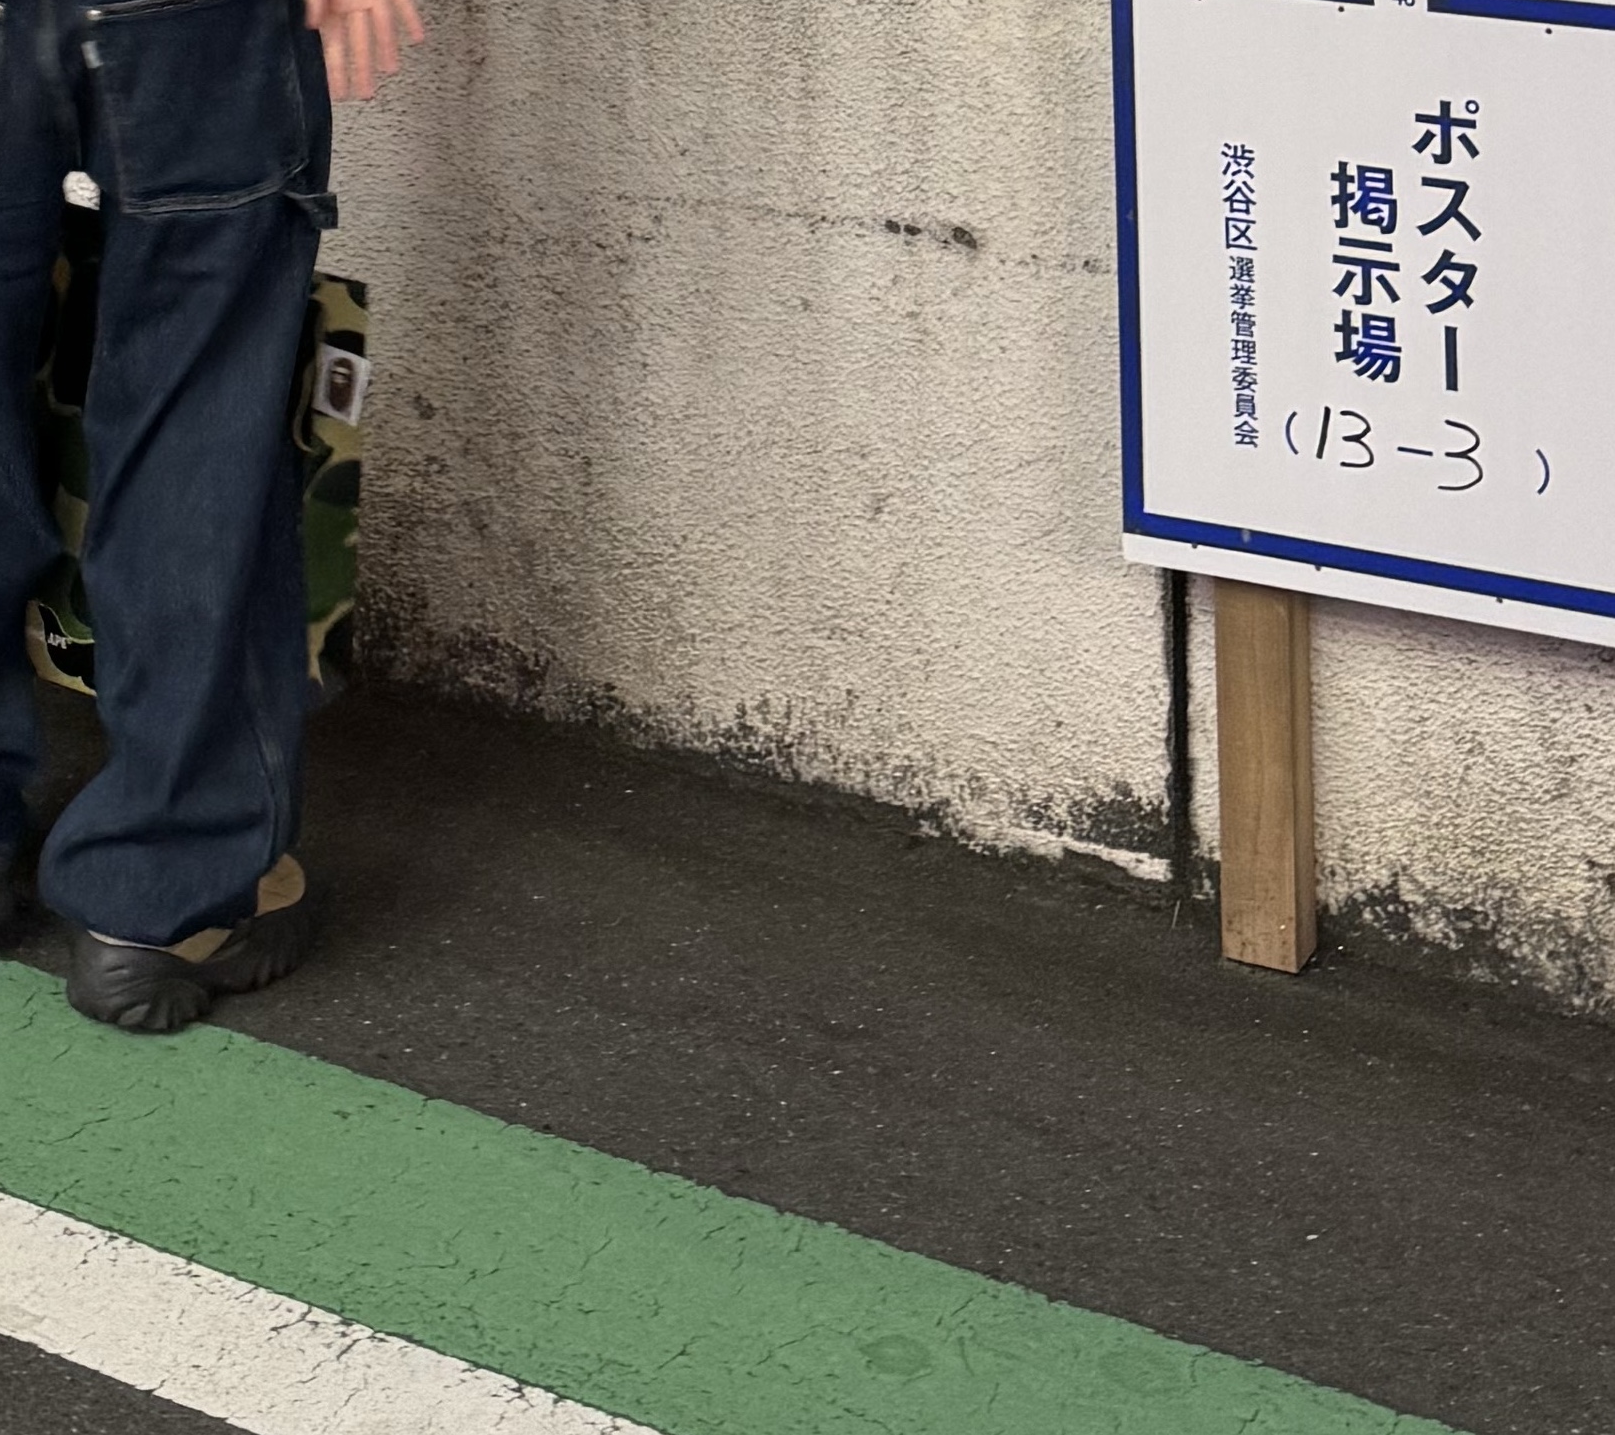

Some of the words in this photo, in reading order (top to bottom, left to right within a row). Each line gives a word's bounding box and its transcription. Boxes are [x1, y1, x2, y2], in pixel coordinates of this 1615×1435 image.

[1330, 160, 1403, 384] 掲示場
[1411, 99, 1482, 392] ポスター
